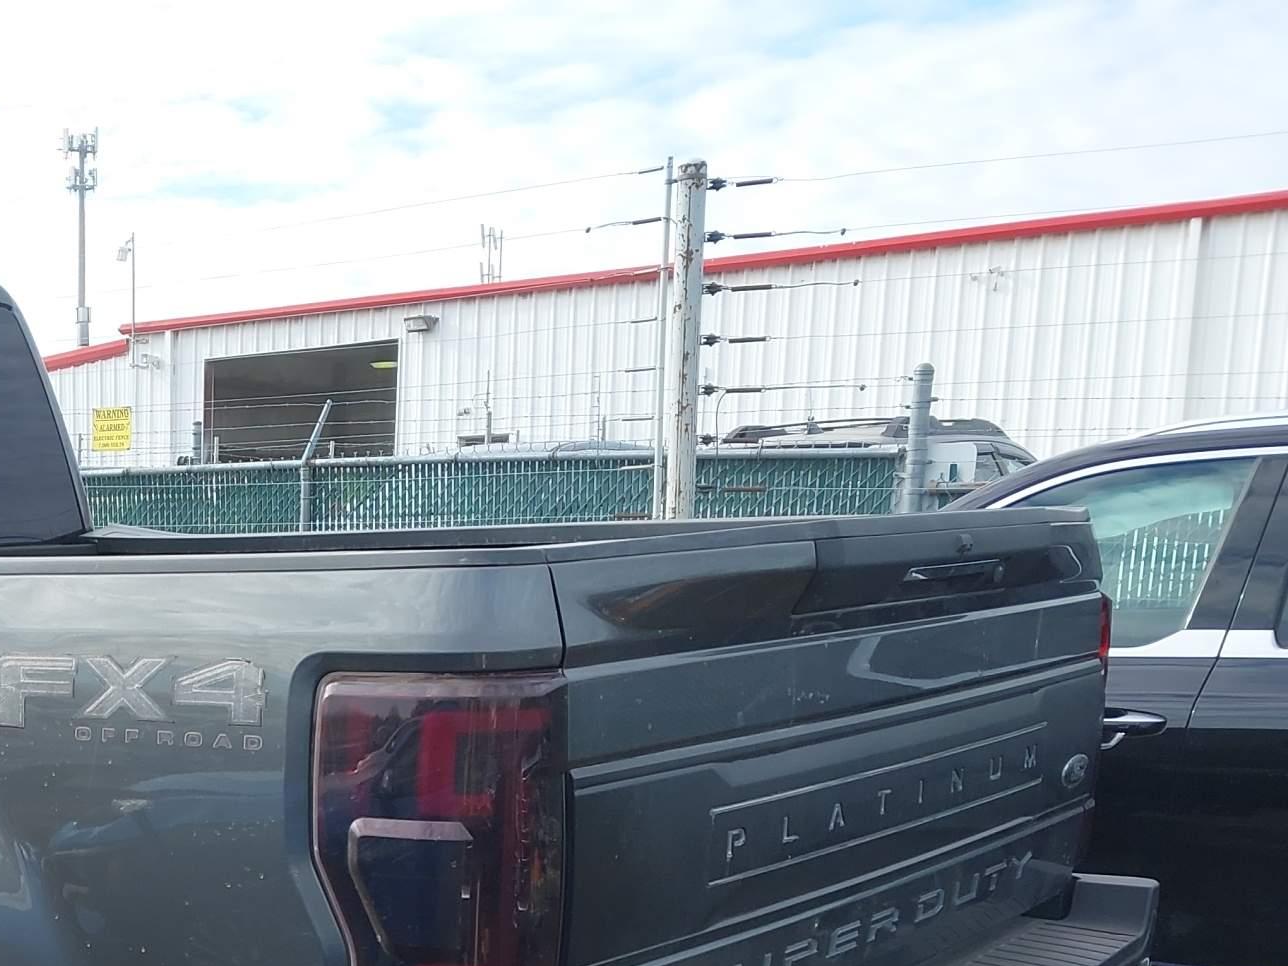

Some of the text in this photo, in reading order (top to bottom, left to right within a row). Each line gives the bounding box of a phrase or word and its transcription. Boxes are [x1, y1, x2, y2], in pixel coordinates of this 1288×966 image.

[95, 409, 129, 419] WARNING
[74, 726, 264, 751] OFF ROAD
[725, 744, 1039, 861] PLATINUM
[914, 851, 1034, 924] DUTY
